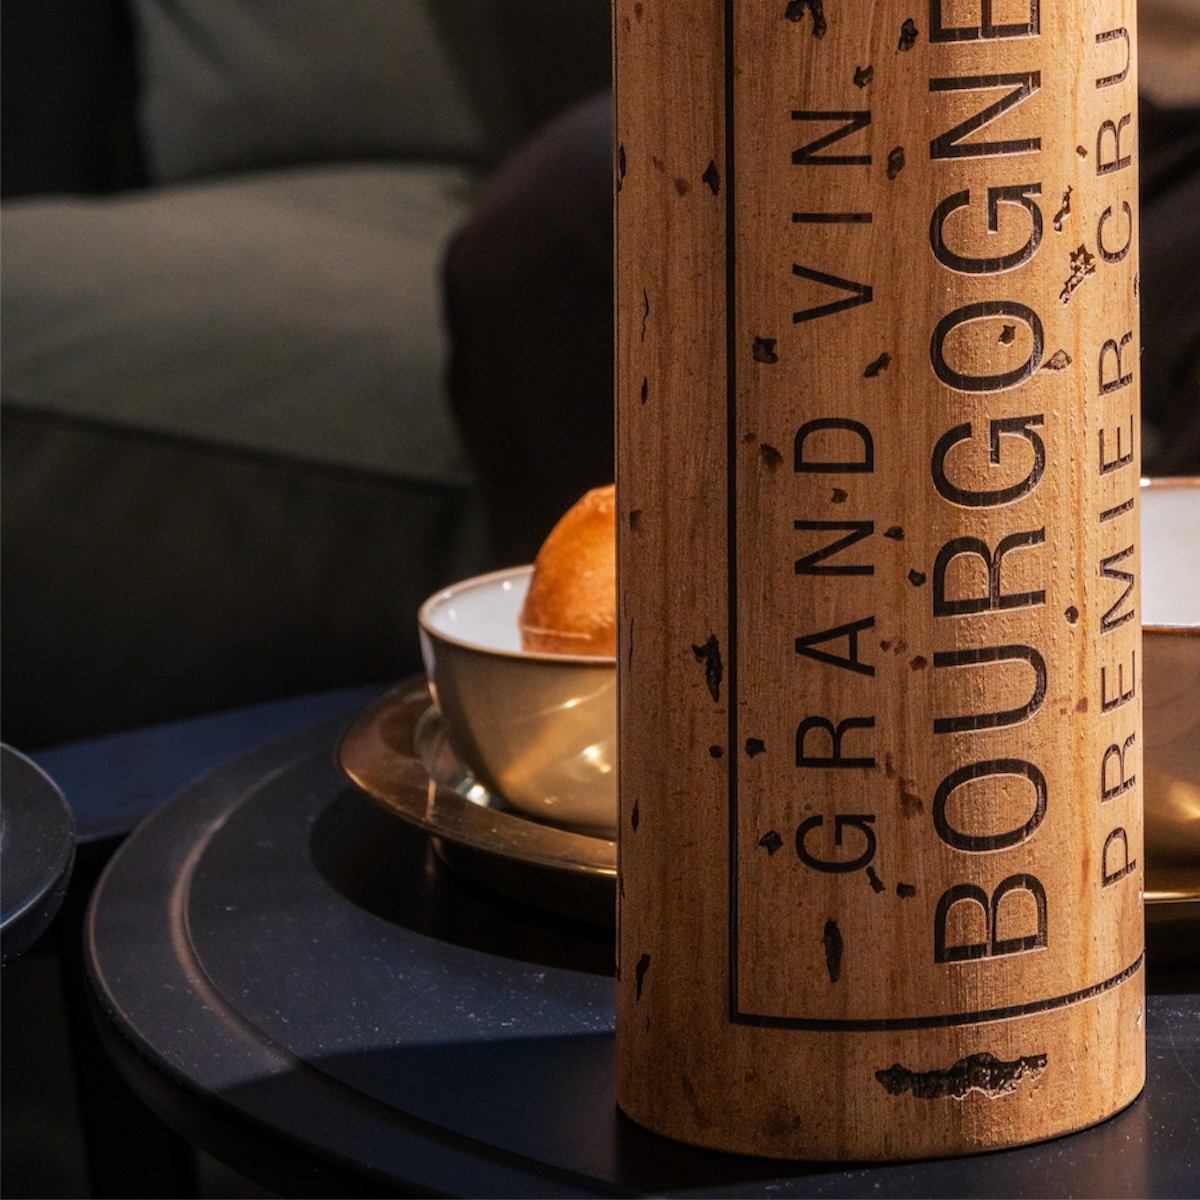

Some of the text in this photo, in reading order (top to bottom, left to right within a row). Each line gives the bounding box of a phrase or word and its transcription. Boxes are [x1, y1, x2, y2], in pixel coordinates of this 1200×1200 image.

[791, 109, 877, 875] GRAND VIN
[1094, 25, 1140, 890] PREMIER CRU
